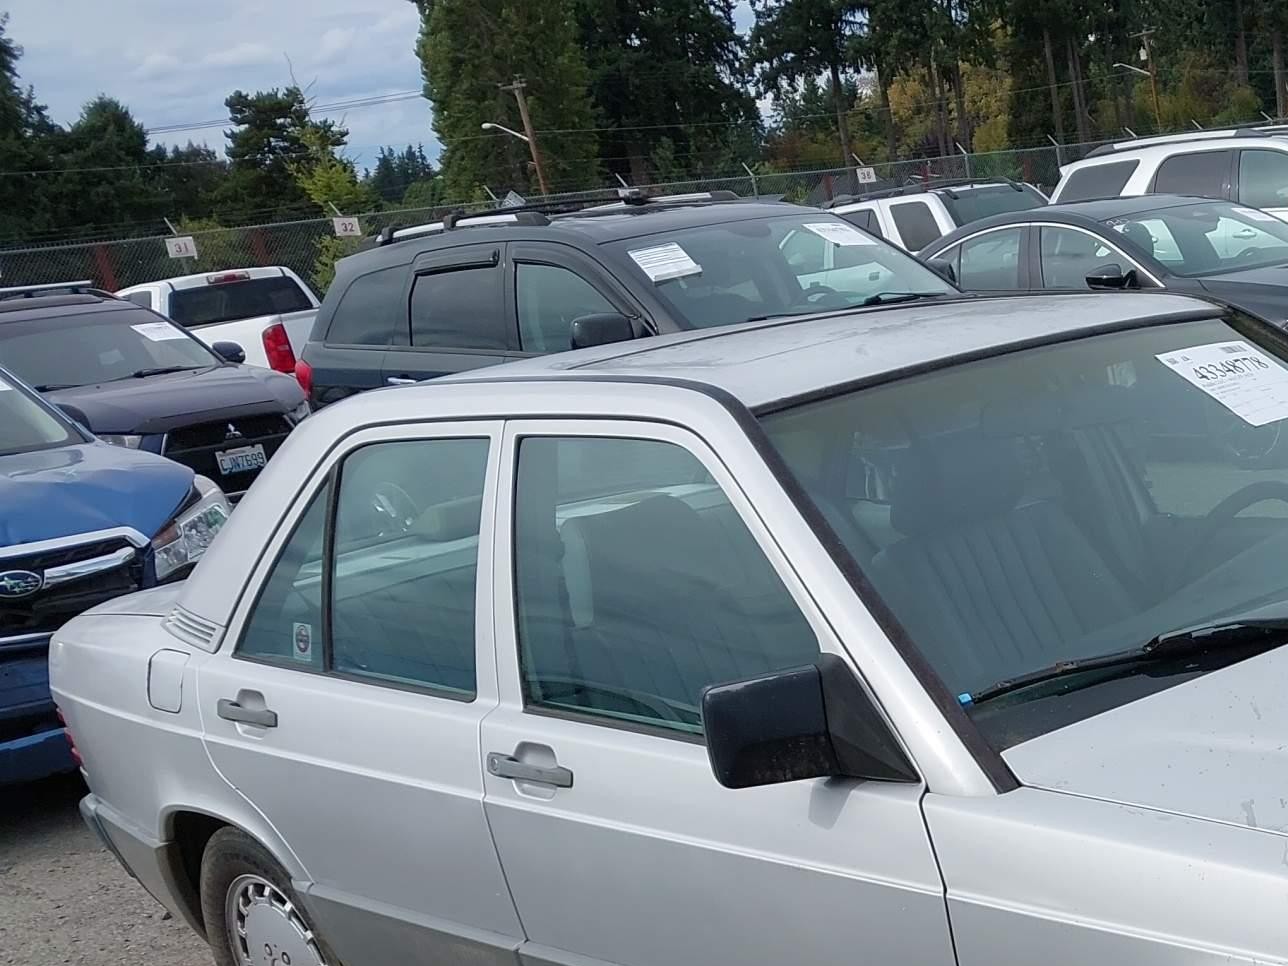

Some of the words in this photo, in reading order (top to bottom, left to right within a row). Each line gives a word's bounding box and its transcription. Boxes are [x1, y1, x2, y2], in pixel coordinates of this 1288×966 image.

[341, 222, 355, 232] 32
[174, 243, 189, 254] 31
[1193, 356, 1269, 381] 43348778
